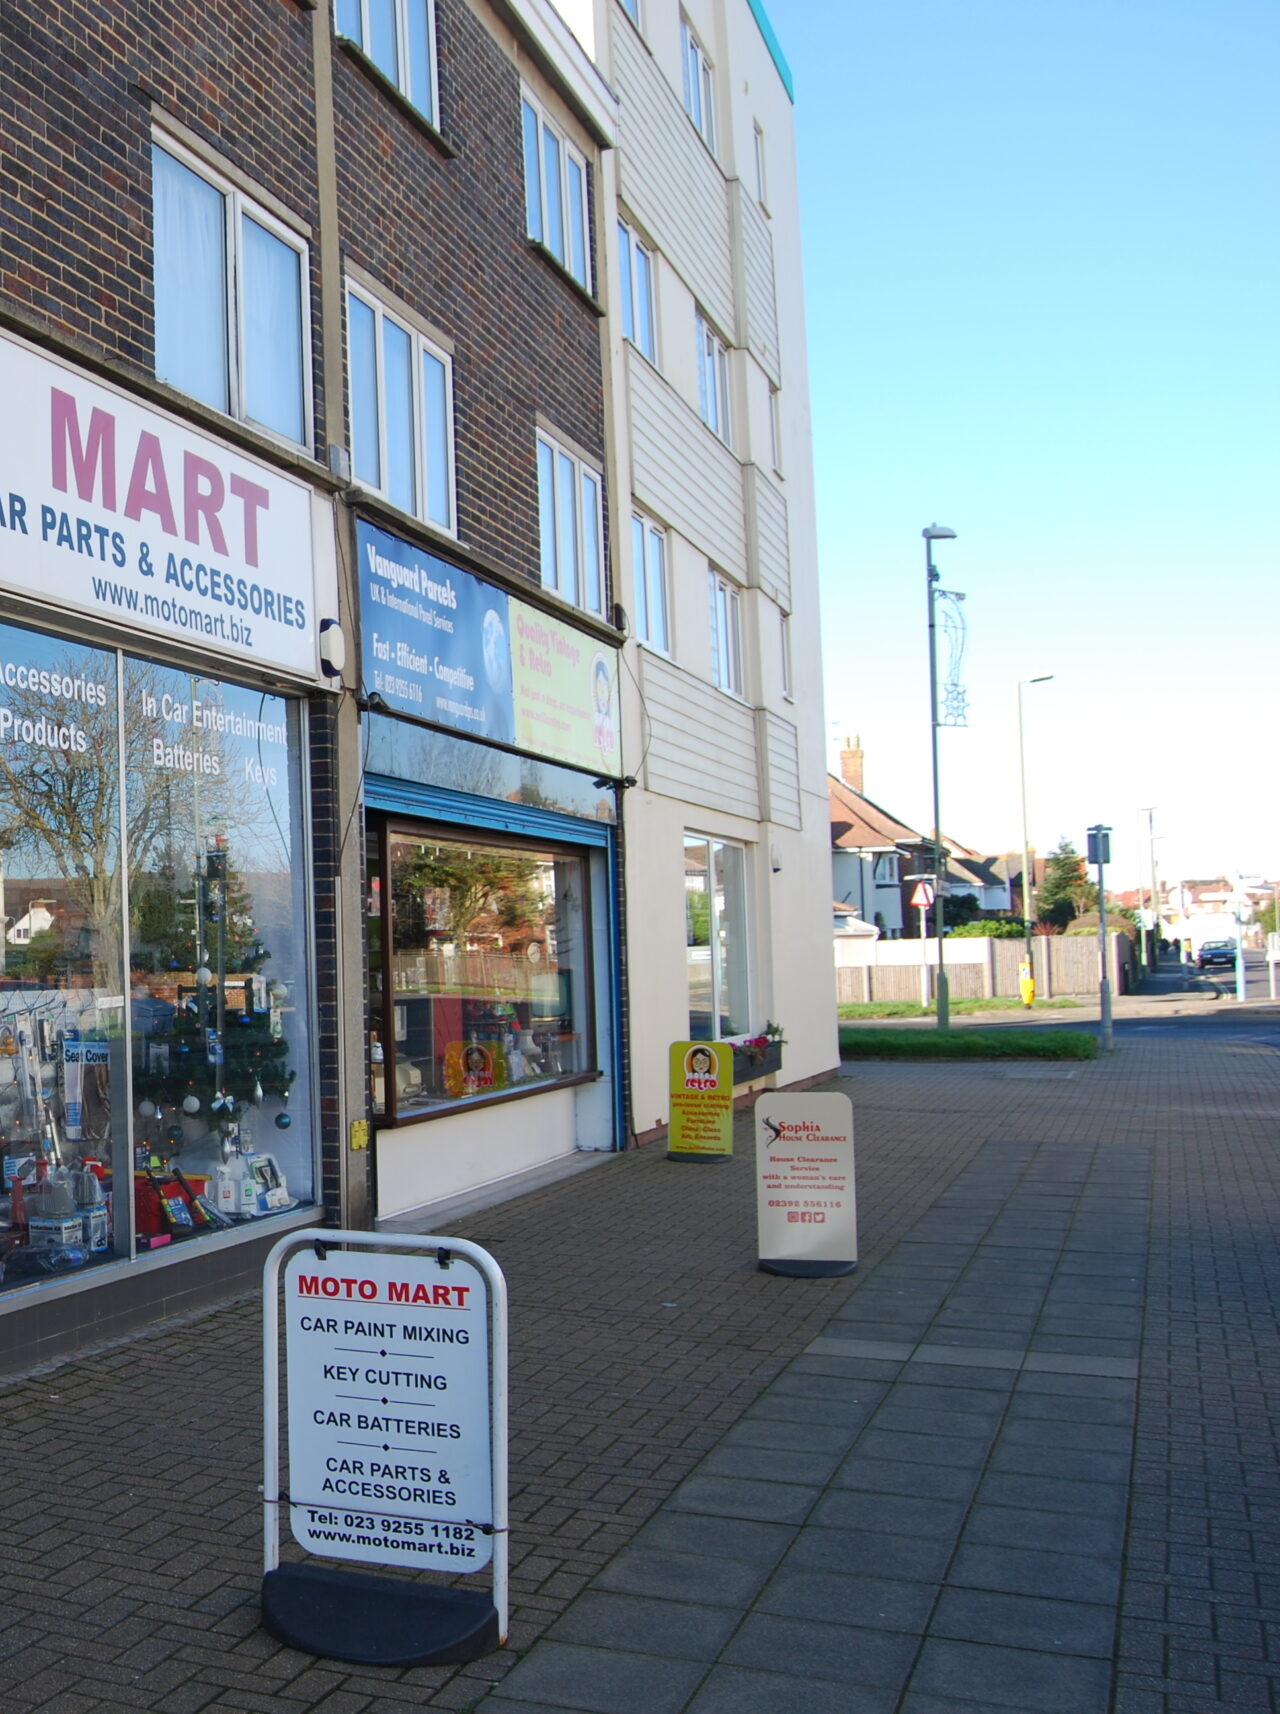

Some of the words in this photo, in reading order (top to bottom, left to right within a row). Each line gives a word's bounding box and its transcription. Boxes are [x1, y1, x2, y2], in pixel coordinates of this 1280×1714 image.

[51, 386, 269, 569] MART
[42, 504, 126, 568] PARTS
[138, 542, 154, 578] &
[165, 551, 306, 630] ACCESSORIES
[366, 543, 420, 594] Vanguard
[420, 569, 457, 610] Parcels
[92, 576, 253, 648] www.motomart.biz
[370, 582, 380, 602] UK
[380, 585, 386, 605] &
[386, 588, 419, 619] International
[373, 632, 389, 662] Fast
[397, 642, 427, 674] Efficient
[434, 656, 474, 691] Competitive
[0, 707, 87, 753] Products
[142, 689, 157, 717] In
[162, 692, 188, 725] Car
[193, 701, 288, 747] Entertainment
[153, 739, 220, 776] Batteries
[245, 756, 277, 790] Keys
[65, 1050, 83, 1063] Seat
[85, 1050, 108, 1063] Cover
[685, 1078, 717, 1090] retro
[778, 1121, 821, 1134] Sophia
[298, 1275, 377, 1300] MOTO
[388, 1282, 469, 1307] MART
[300, 1316, 338, 1334] CAR
[344, 1320, 396, 1339] PAINT
[403, 1325, 469, 1345] MIXING
[324, 1364, 359, 1382] KEY
[365, 1368, 447, 1391] CUTTING
[313, 1410, 351, 1428] CAR
[358, 1414, 461, 1439] BATTERIES
[326, 1457, 363, 1475] CAR
[370, 1462, 431, 1483] PARTS
[438, 1468, 451, 1485] &
[322, 1478, 457, 1506] ACCESSORIES
[307, 1510, 338, 1526] Tel:
[344, 1515, 375, 1531] 023
[381, 1519, 424, 1536] 9255
[431, 1524, 475, 1542] 1182
[307, 1528, 476, 1559] www.motomart.biz
